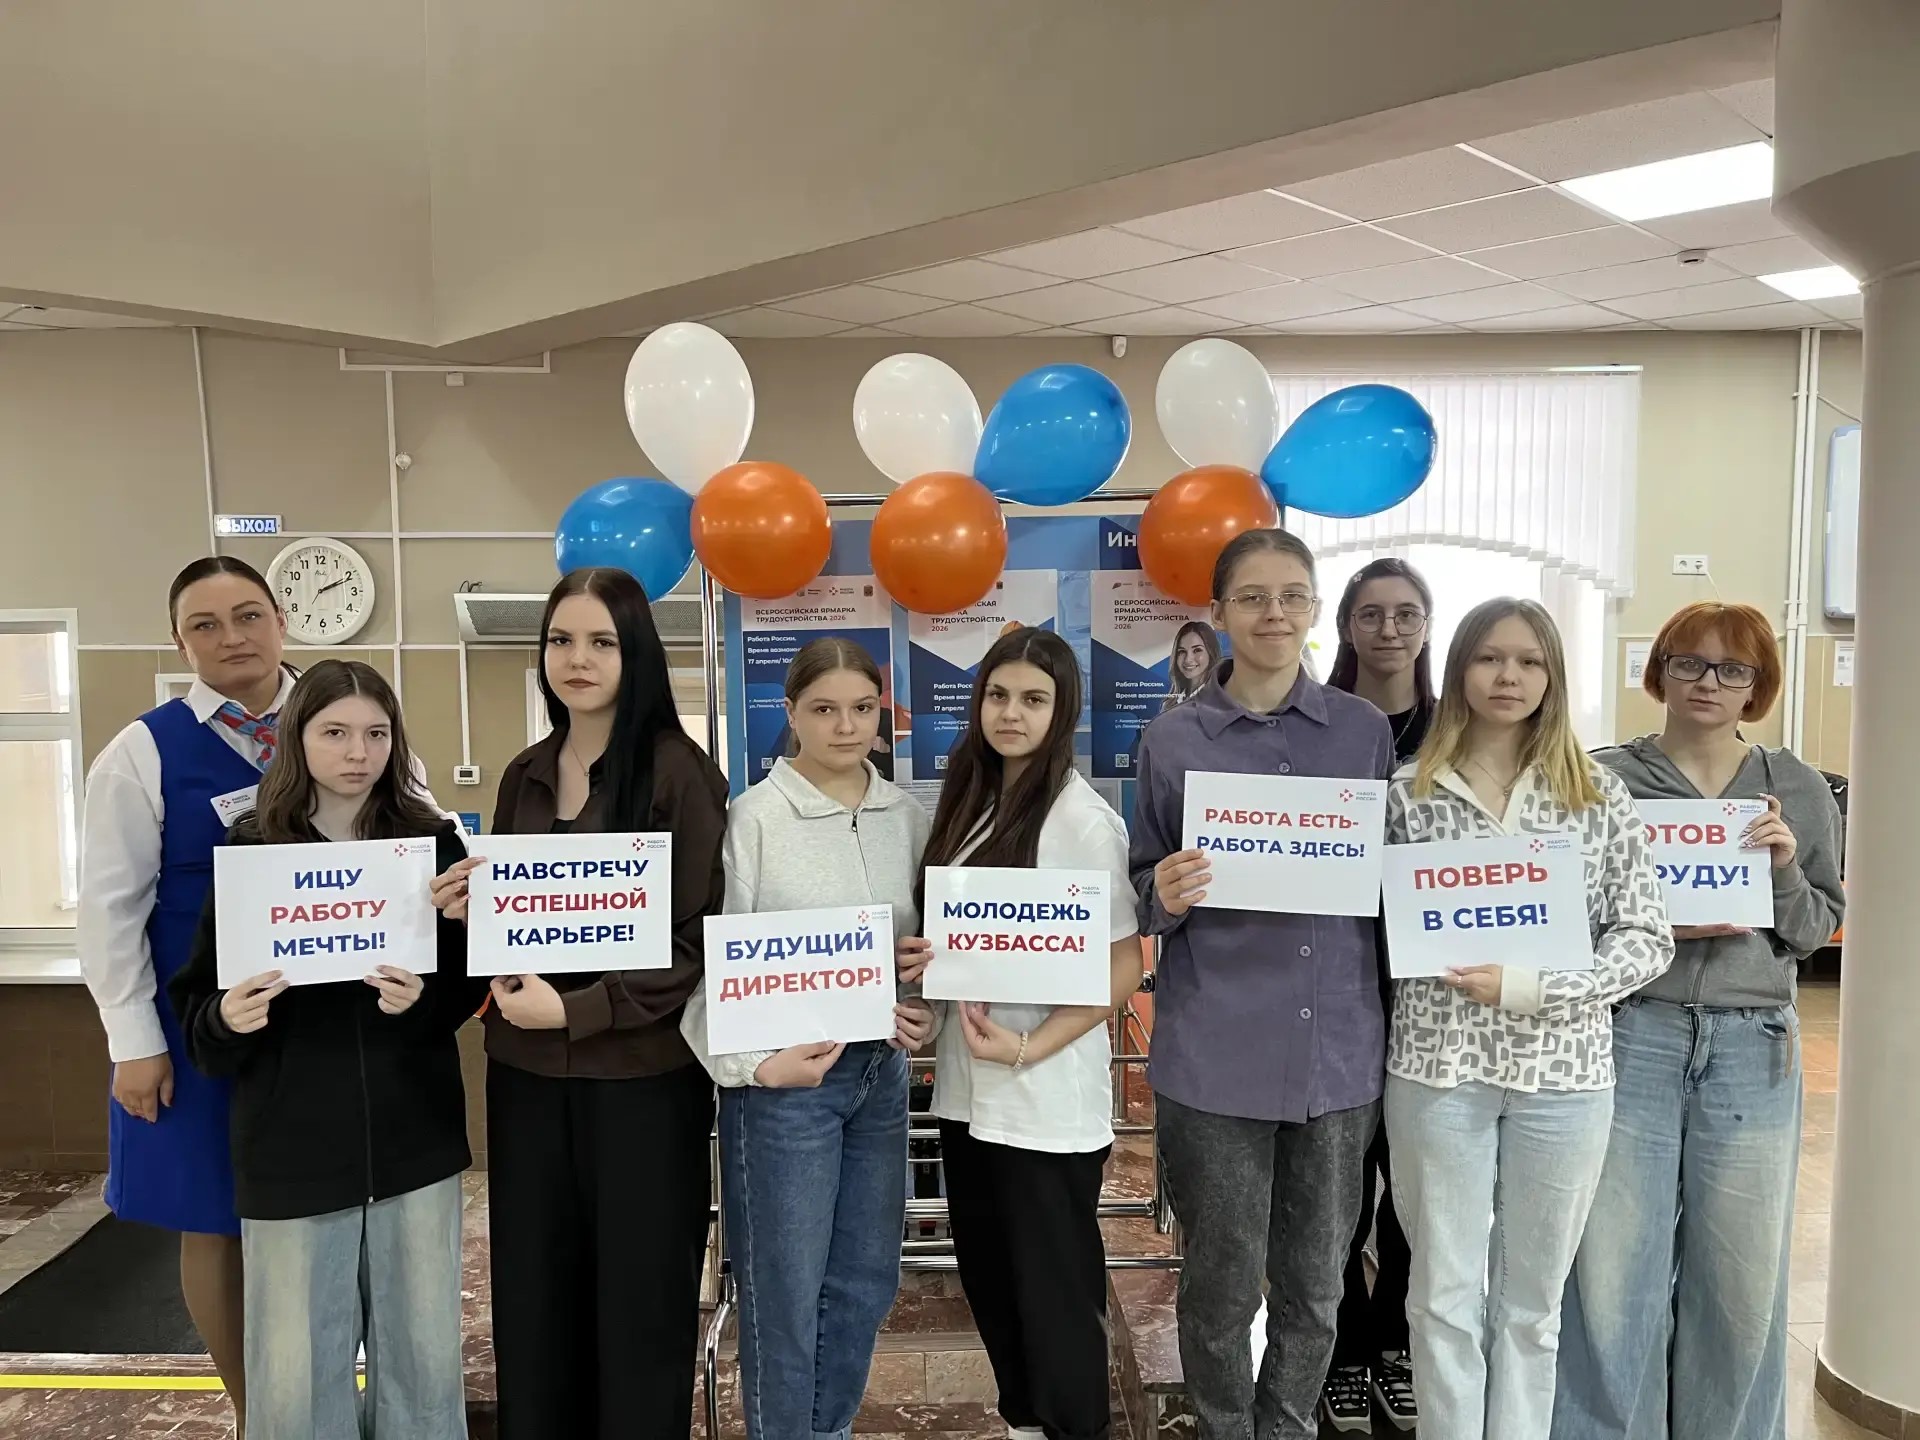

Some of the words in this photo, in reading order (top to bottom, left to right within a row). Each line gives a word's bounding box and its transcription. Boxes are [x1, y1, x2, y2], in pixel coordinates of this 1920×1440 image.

[220, 518, 276, 532] ЫХОД
[300, 560, 309, 569] 11
[315, 556, 326, 564] 12
[334, 560, 339, 569] 1
[290, 572, 300, 580] 10
[345, 571, 353, 580] 2
[285, 587, 292, 596] 9
[351, 587, 358, 596] 3
[291, 603, 298, 612] 8
[346, 603, 353, 612] 4
[755, 607, 819, 615] ВСЕРОССИЙСКАЯ
[305, 614, 311, 624] 7
[320, 618, 327, 628] 6
[336, 614, 343, 623] 5
[756, 615, 828, 623] ТРУДОУСТРОЙСТВА
[931, 616, 1006, 624] ТРУДОУСТРОЙСТВА
[1114, 614, 1190, 622] ТРУДОУСТРОЙСТВА
[1205, 808, 1293, 827] РАБОТА
[1299, 813, 1359, 829] ЕСТЬ-
[1644, 824, 1727, 845] ТОВ
[1196, 836, 1284, 854] РАБОТА
[1290, 841, 1365, 859] ЗДЕСЬ!
[492, 859, 649, 881] НАВСТРЕЧУ
[1414, 862, 1548, 890] ПОВЕРЬ
[1655, 864, 1749, 890] РУДУ!
[294, 868, 363, 890] ИЩУ
[493, 887, 647, 914] УСПЕШНОЙ
[270, 900, 387, 924] РАБОТУ
[943, 901, 1091, 923] МОЛОДЕЖЬ
[1423, 910, 1444, 931] В
[1453, 903, 1548, 930] СЕБЯ!
[507, 924, 635, 947] КАРЬЕРЕ!
[273, 932, 386, 958] МЕЧТЫ!
[725, 926, 873, 961] БУДУЩИЙ
[947, 933, 1085, 953] КУЗБАССА!
[719, 966, 882, 1003] ДИРЕКТОР!
